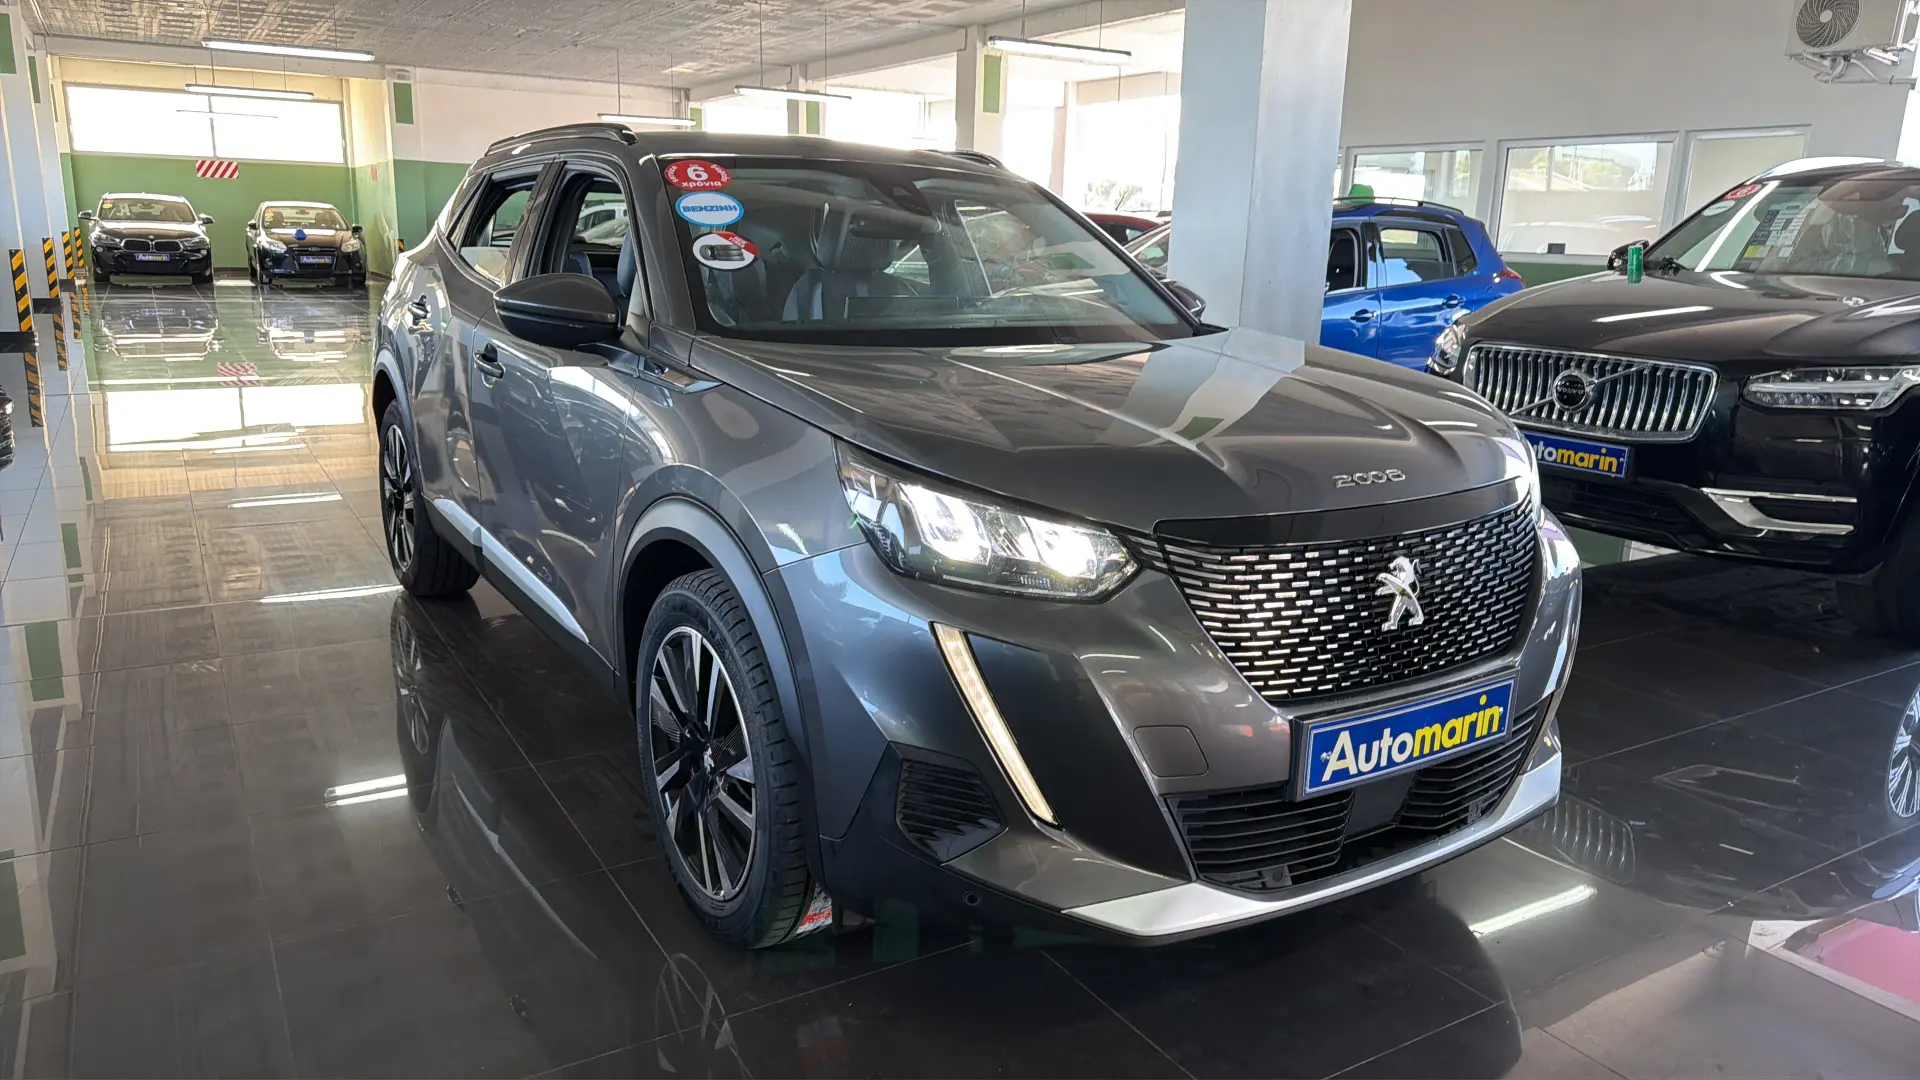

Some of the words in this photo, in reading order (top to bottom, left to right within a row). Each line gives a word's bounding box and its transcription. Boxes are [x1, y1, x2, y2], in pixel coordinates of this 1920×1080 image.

[681, 180, 722, 188] χρόνια
[687, 166, 708, 181] 6
[1532, 440, 1617, 473] tomarin
[1331, 468, 1406, 489] 2008
[1321, 694, 1501, 783] Automarin
